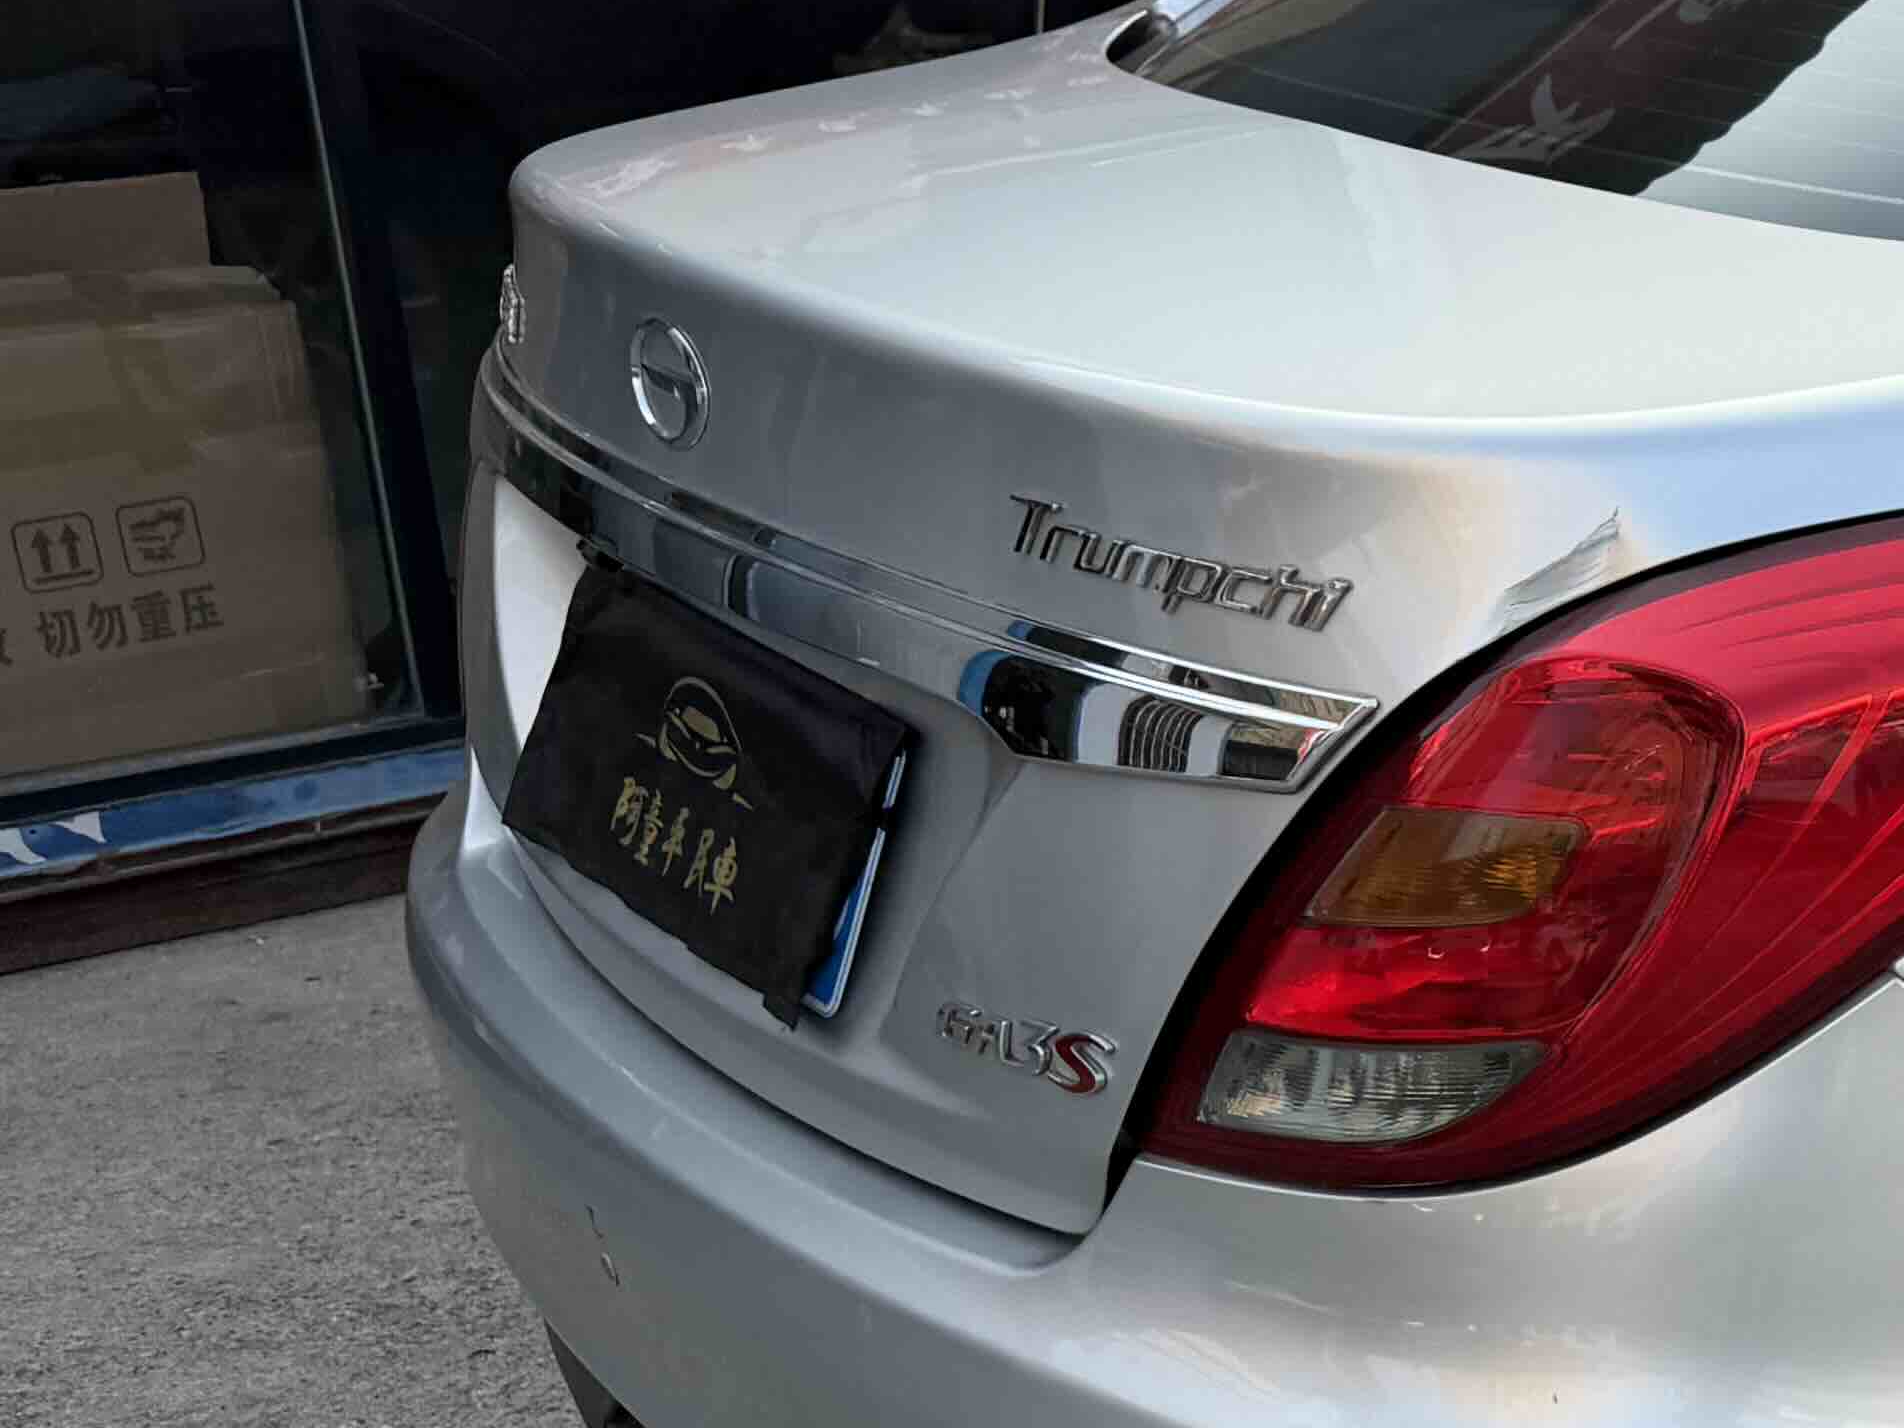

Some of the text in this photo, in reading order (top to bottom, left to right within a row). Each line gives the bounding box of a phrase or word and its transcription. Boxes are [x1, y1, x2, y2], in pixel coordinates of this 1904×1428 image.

[1009, 493, 1354, 633] Trumpchi
[37, 580, 225, 659] 切勿重压
